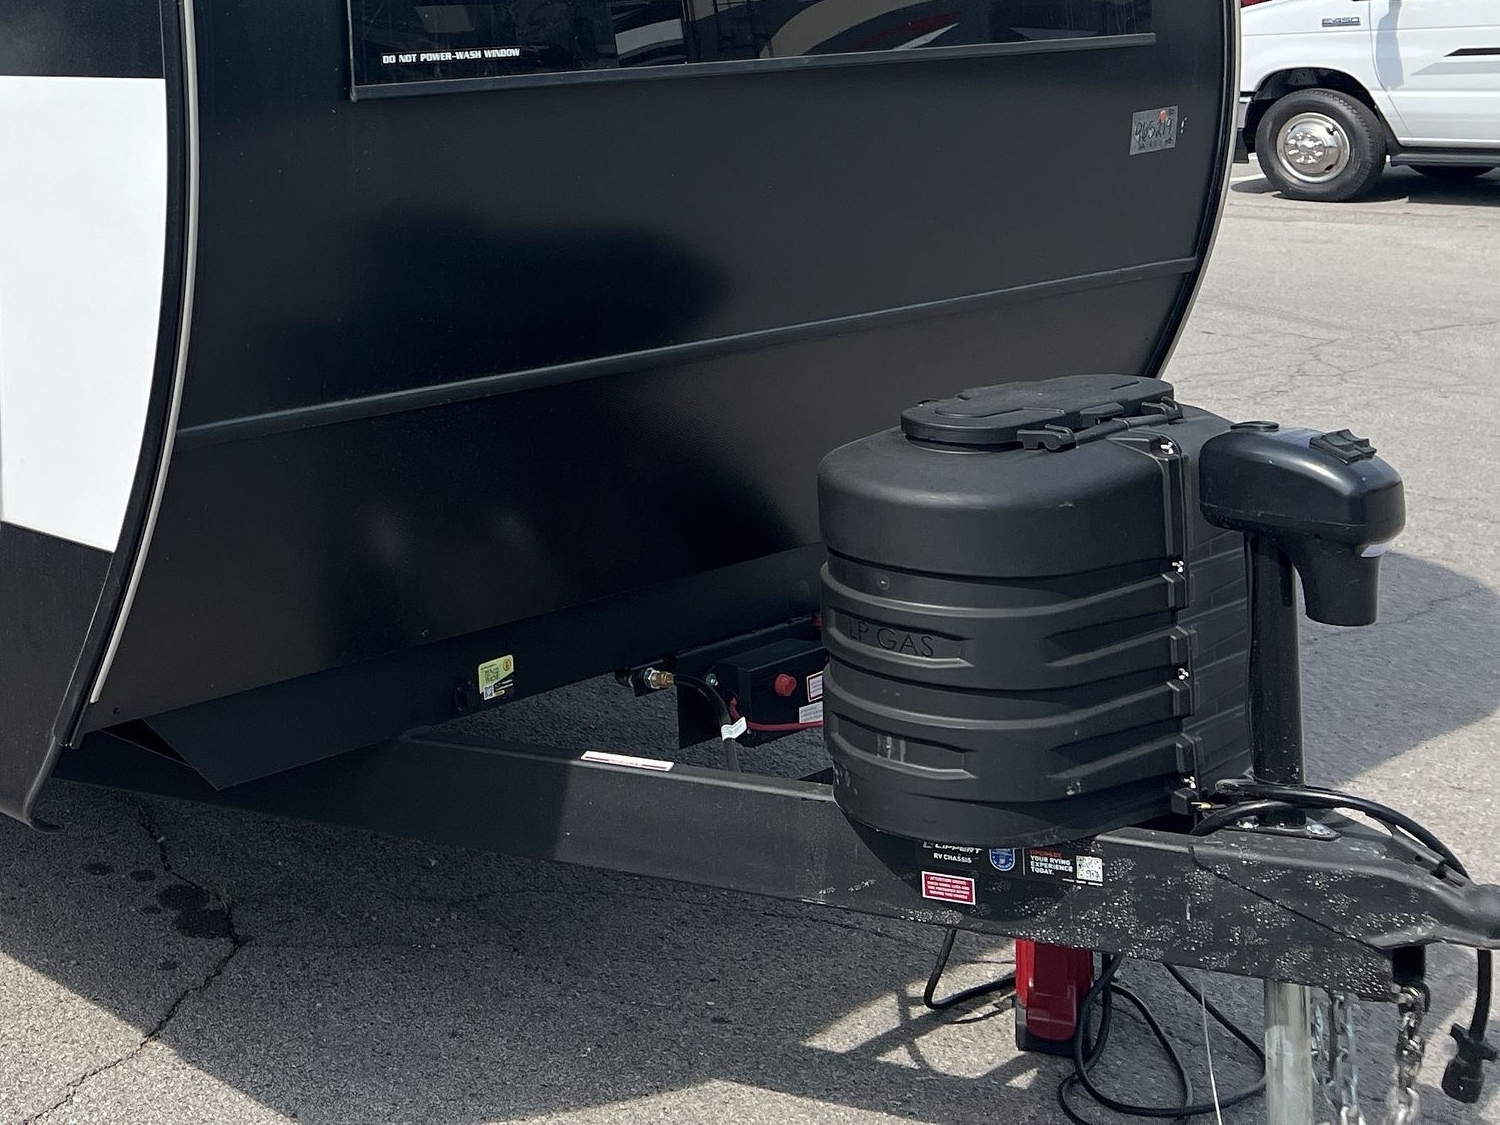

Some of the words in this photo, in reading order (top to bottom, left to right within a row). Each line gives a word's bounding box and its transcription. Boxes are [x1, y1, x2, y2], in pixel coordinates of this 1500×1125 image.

[382, 55, 396, 64] DO
[398, 53, 417, 63] NOT
[419, 50, 482, 62] POWER-WASH
[483, 48, 521, 59] WINDOW
[849, 618, 869, 643] LP
[877, 627, 934, 658] GAS
[933, 852, 943, 860] RV
[943, 854, 973, 864] CHASSIS
[1030, 855, 1049, 863] YOUR
[1049, 857, 1071, 866] RVING
[1030, 861, 1074, 873] EXPERIENCE
[1030, 866, 1055, 876] TODAY.
